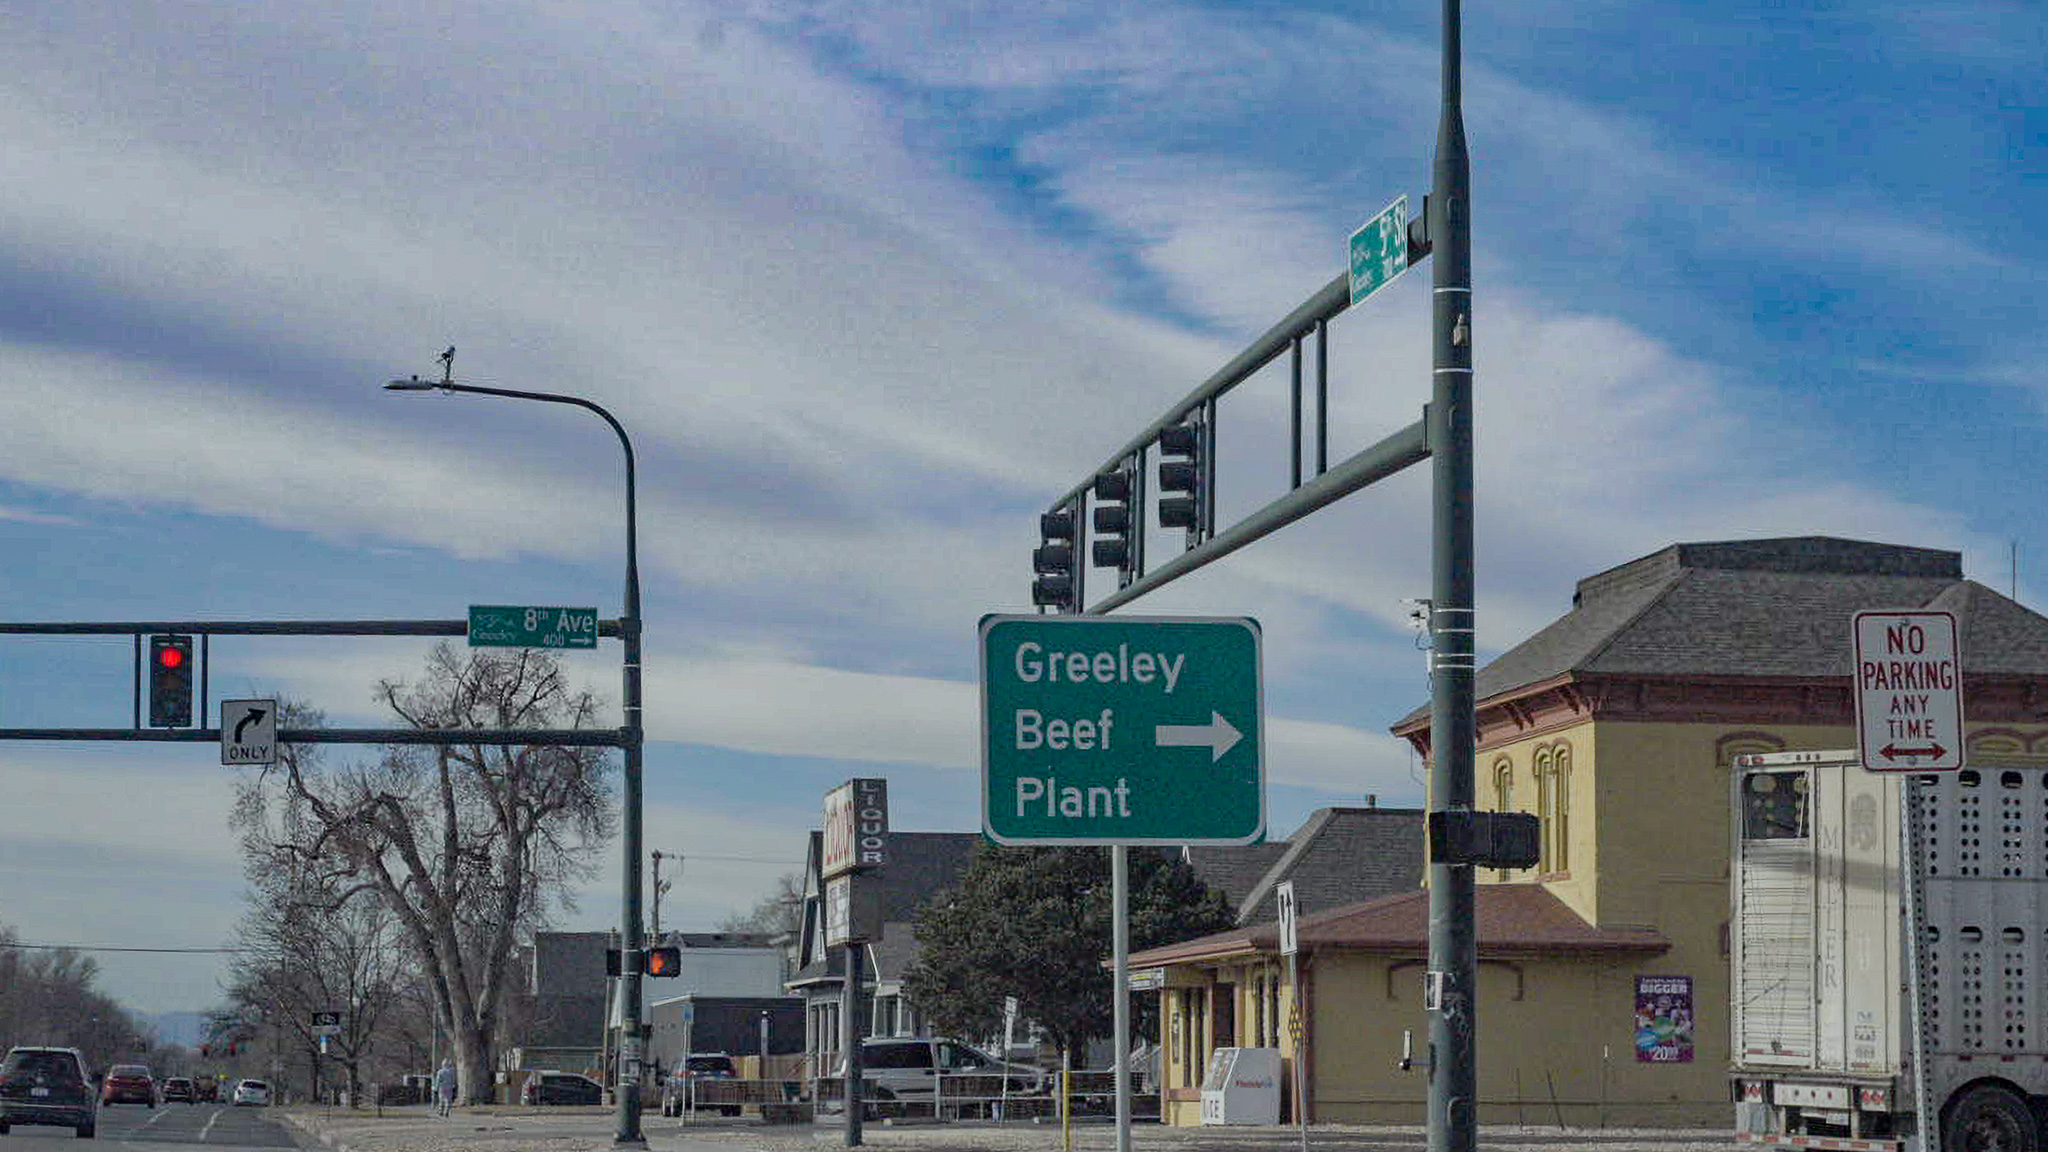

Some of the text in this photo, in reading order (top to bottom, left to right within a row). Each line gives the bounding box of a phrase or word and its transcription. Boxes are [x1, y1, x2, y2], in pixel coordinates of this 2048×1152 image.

[523, 608, 594, 633] 8th Ave
[1887, 625, 1924, 655] NO
[1015, 641, 1185, 693] Greeley
[1863, 660, 1953, 690] PARKING
[1891, 694, 1929, 715] ANY
[1015, 707, 1113, 750] Beef
[1886, 718, 1935, 740] TIME
[229, 745, 268, 760] ONLY
[1016, 776, 1132, 818] Plant
[860, 779, 884, 865] LIQUOR
[1639, 983, 1688, 994] BIGGER
